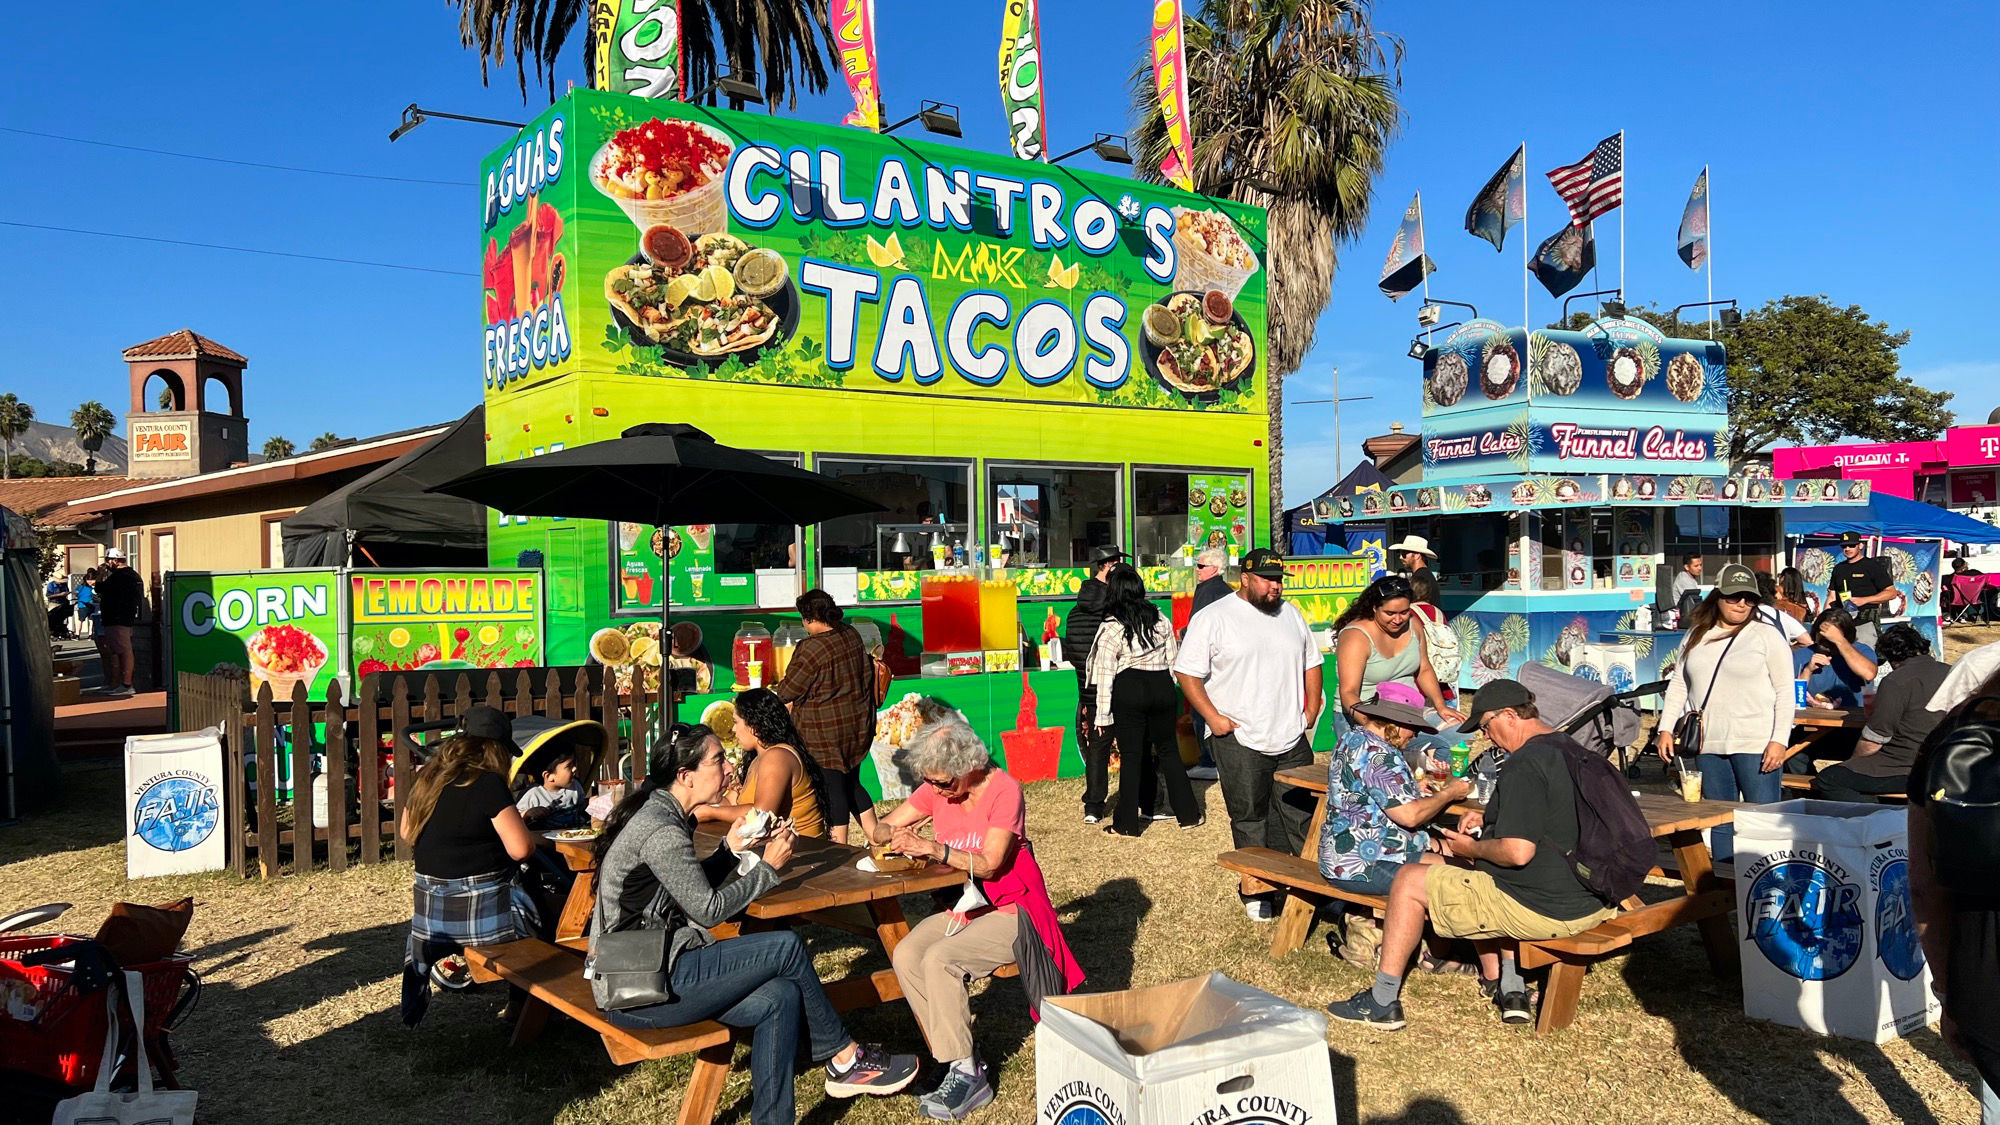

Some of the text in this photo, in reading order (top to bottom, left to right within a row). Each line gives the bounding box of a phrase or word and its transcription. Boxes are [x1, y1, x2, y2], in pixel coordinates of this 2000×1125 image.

[484, 113, 564, 230] AGUAS
[727, 145, 1176, 283] CILANTRO'S
[484, 292, 571, 390] FRESCA
[800, 259, 1130, 388] TACOS
[136, 433, 188, 452] FAIR
[1428, 431, 1522, 461] Funnel Cakes
[1551, 423, 1707, 461] Funnel Cakes
[1281, 562, 1365, 590] EMONADE
[181, 584, 327, 636] CORN
[352, 576, 534, 624] LEMONADE
[134, 769, 210, 796] VENTURA COUNTY
[133, 785, 220, 836] FAIR
[1743, 849, 1850, 881] VENTURA COUNTY
[1871, 848, 1908, 892] VENTURA COU
[1746, 883, 1865, 941] FAIR
[1043, 1080, 1127, 1125] VENTURA COUN
[1236, 1096, 1313, 1123] COUNTY
